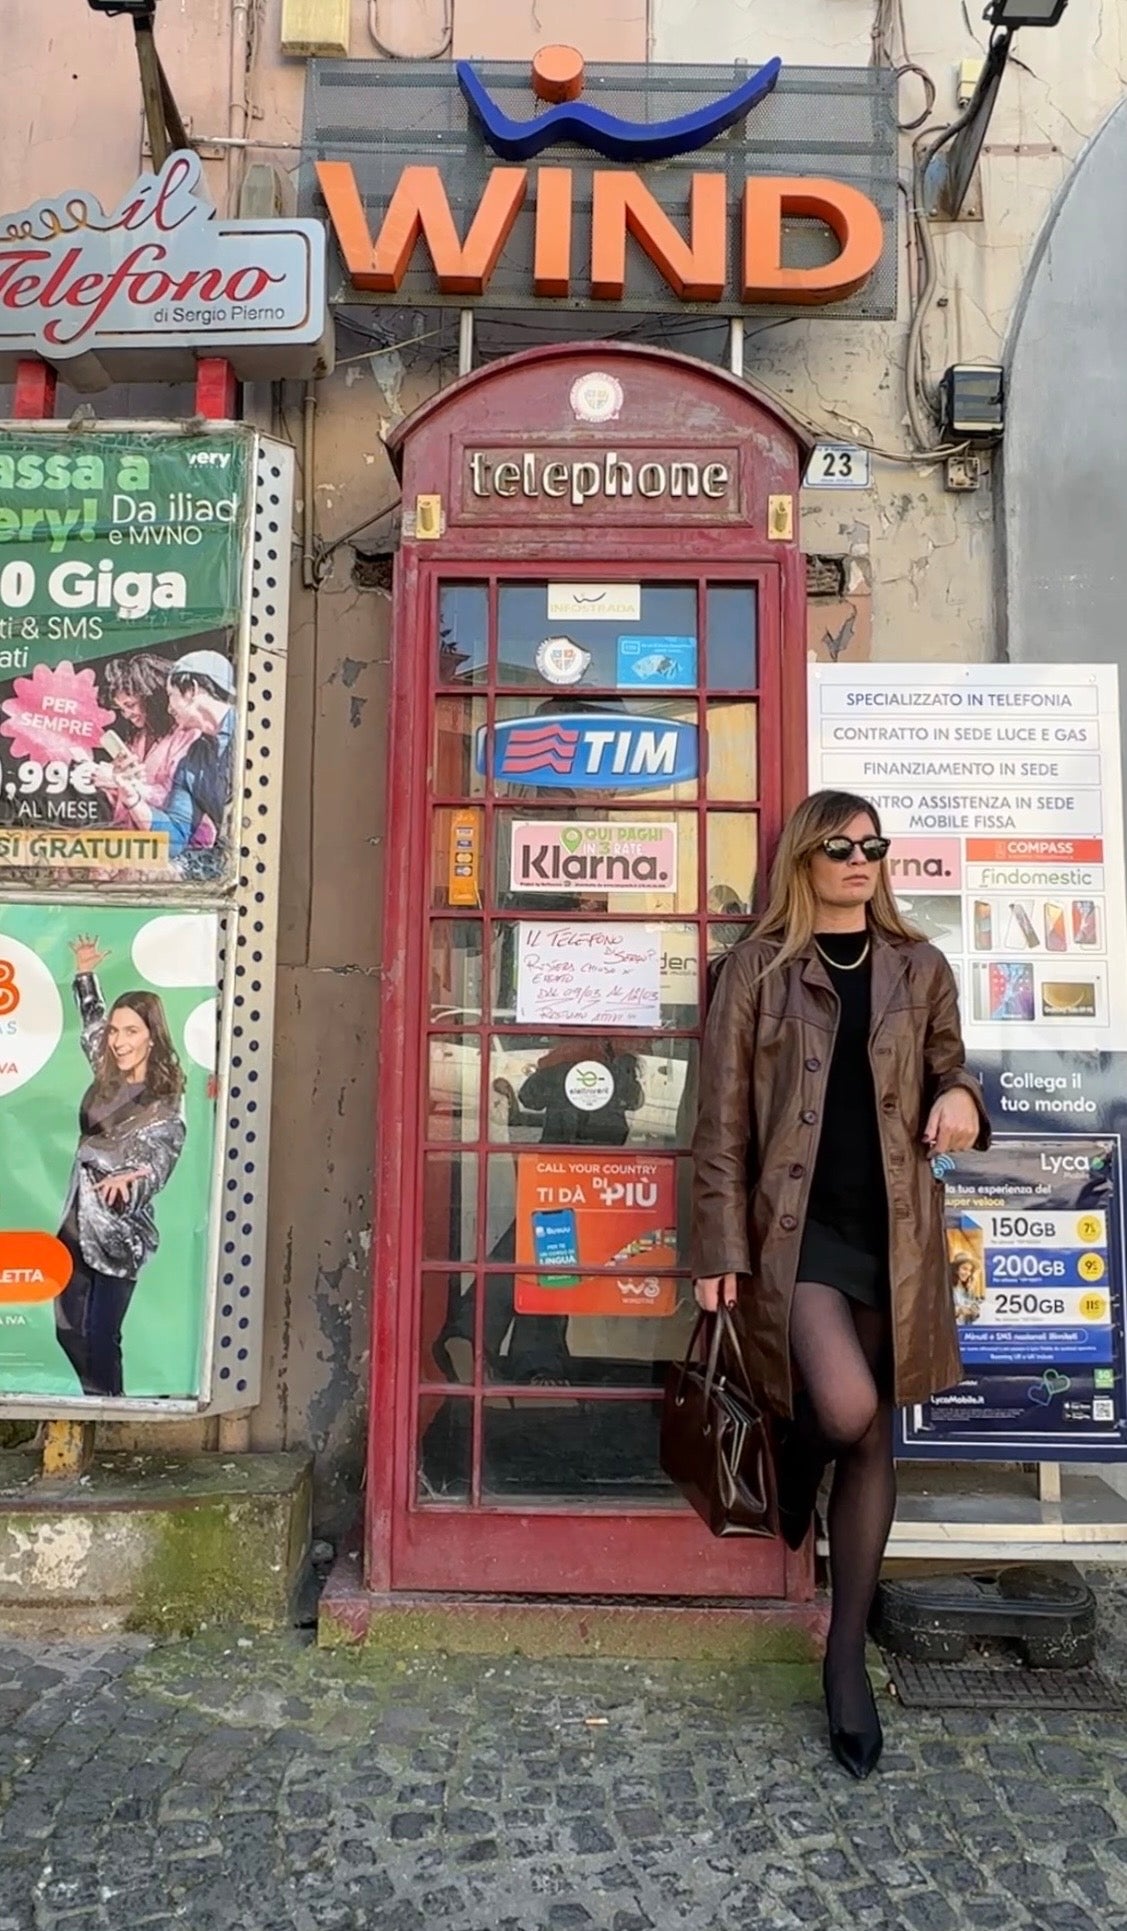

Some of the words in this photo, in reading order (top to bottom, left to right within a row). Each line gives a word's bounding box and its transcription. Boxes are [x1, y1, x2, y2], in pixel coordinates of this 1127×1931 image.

[113, 158, 197, 231] il
[315, 161, 884, 304] WIND
[0, 244, 286, 345] Telefono
[154, 306, 169, 323] di
[173, 306, 228, 325] Sergio
[231, 305, 285, 321] Pierno
[186, 451, 231, 467] very
[823, 452, 852, 477] 23
[117, 454, 149, 491] a
[471, 451, 730, 506] telephone
[113, 494, 156, 524] Da
[169, 492, 238, 524] iliad
[109, 529, 123, 545] e
[130, 526, 202, 545] MVNO
[48, 559, 187, 620] Giga
[551, 603, 635, 613] INFOSTRADA
[21, 616, 39, 640] &
[48, 616, 103, 640] SMS
[42, 696, 78, 713] PER
[846, 692, 962, 707] SPECIALIZZATO
[967, 693, 984, 706] IN
[988, 693, 1072, 708] TELEFONIA
[20, 712, 94, 737] SEMPRE
[833, 727, 928, 741] CONTRATTO
[934, 728, 949, 741] IN
[954, 728, 991, 741] SEDE
[997, 728, 1036, 742] LUCE
[1042, 729, 1050, 741] E
[1055, 729, 1087, 743] GAS
[583, 731, 679, 775] TIM
[864, 762, 994, 776] FINANZIAMENTO
[1000, 763, 1016, 776] IN
[1021, 763, 1059, 777] SEDE
[18, 800, 42, 818] AL
[47, 801, 99, 819] MESE
[864, 796, 913, 809] NTRO
[918, 796, 1011, 810] ASSISTENZA
[1016, 797, 1032, 810] IN
[1037, 797, 1075, 811] SEDE
[909, 815, 968, 829] MOBILE
[974, 816, 1016, 830] FISSA
[585, 827, 612, 842] QUI
[617, 828, 663, 842] PAGHI
[30, 837, 159, 860] GRATUITI
[583, 843, 595, 854] IN
[600, 841, 611, 855] 3
[614, 844, 643, 854] RATE
[1007, 842, 1074, 854] COMPASS
[522, 845, 668, 881] Klarna.
[547, 927, 623, 948] TELEFONO
[1000, 1072, 1067, 1093] Collega
[1072, 1072, 1082, 1088] il
[1000, 1096, 1029, 1112] tuo
[1035, 1097, 1096, 1112] mondo
[537, 1163, 566, 1174] CALL
[569, 1164, 600, 1175] YOUR
[603, 1164, 657, 1175] COUNTRY
[1040, 1153, 1090, 1174] Lyca
[537, 1188, 553, 1203] TI
[560, 1184, 586, 1203] DÀ
[592, 1178, 608, 1190] DI
[958, 1184, 975, 1193] tua
[978, 1184, 1032, 1195] esperienza
[992, 1217, 1055, 1237] 150GB
[992, 1255, 1065, 1276] 200GB
[0, 1268, 45, 1284] ETTA
[995, 1294, 1065, 1314] 250GB
